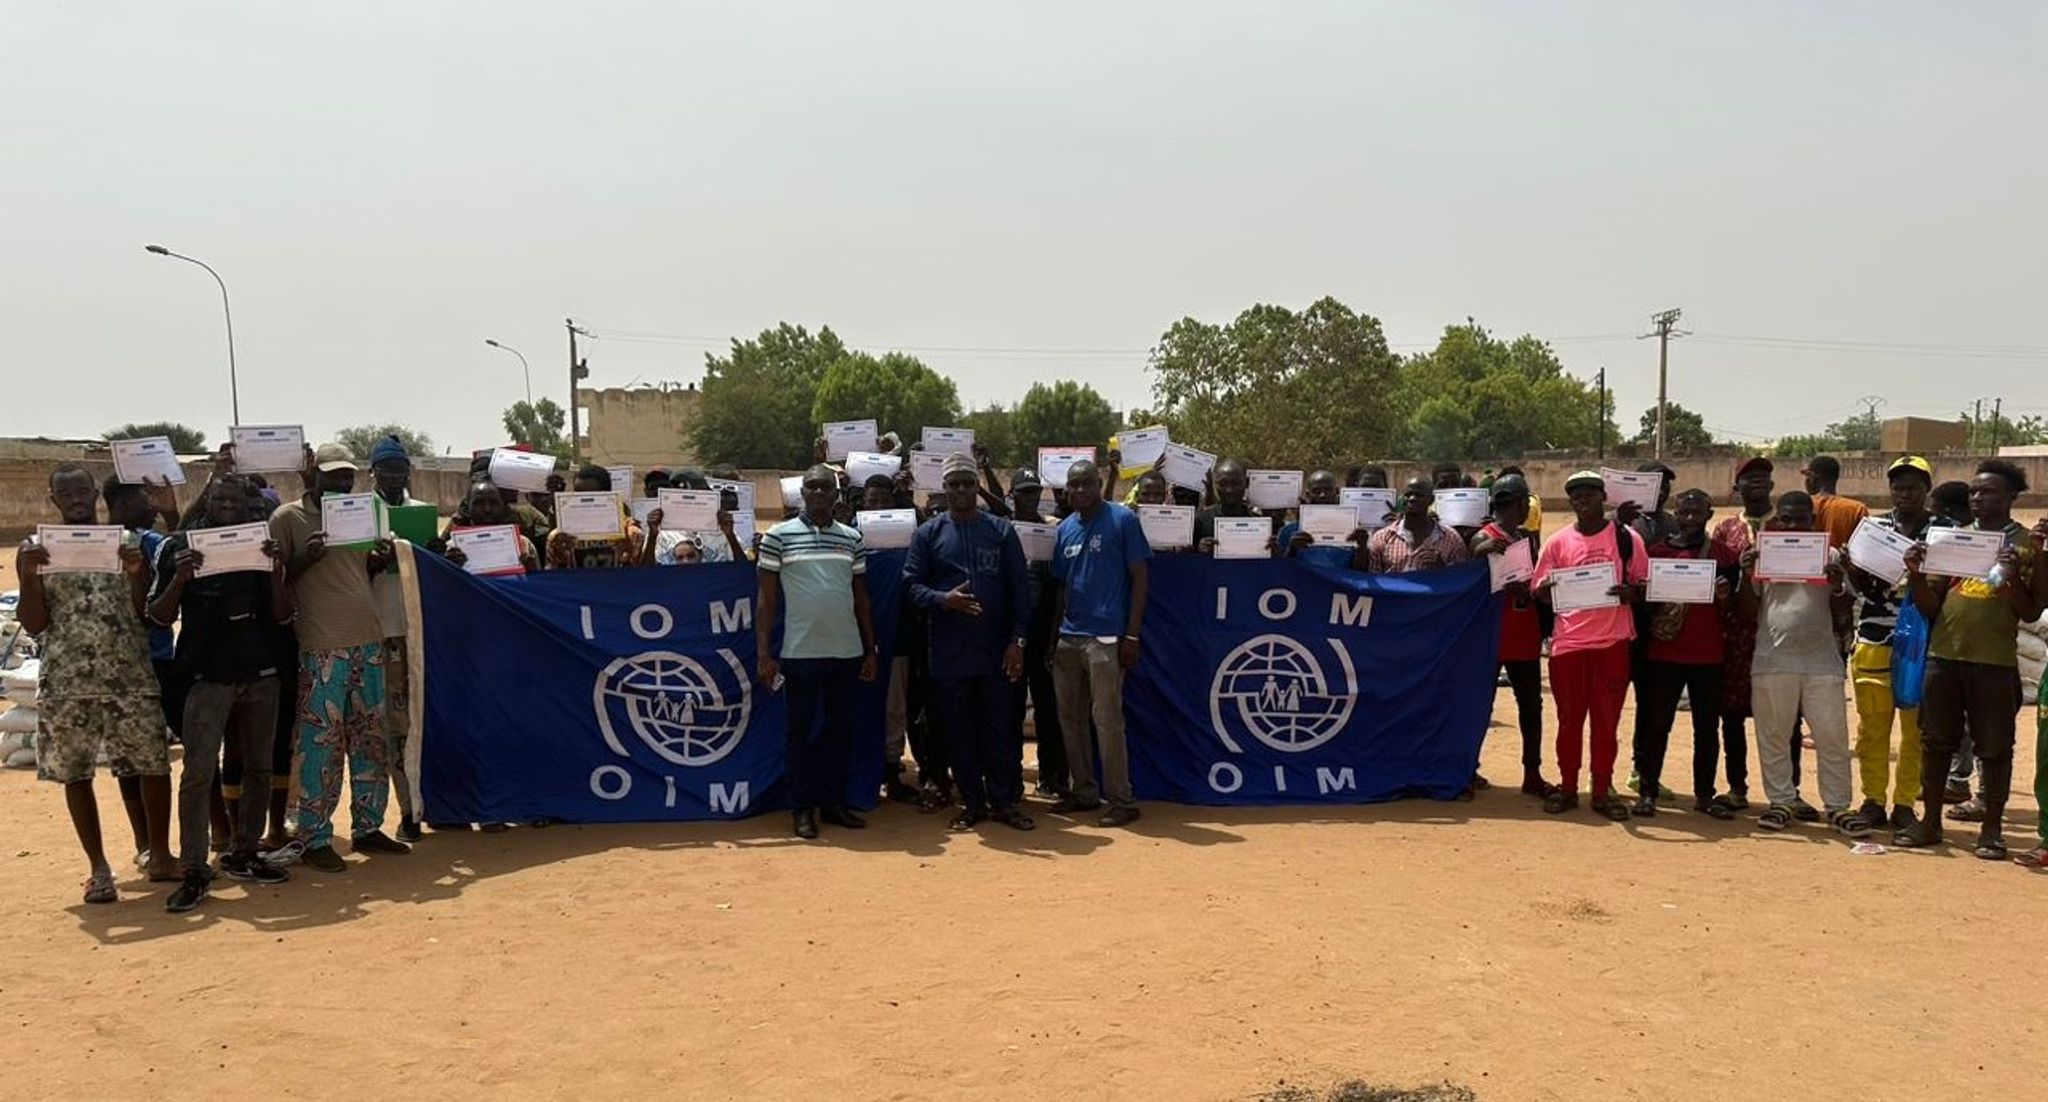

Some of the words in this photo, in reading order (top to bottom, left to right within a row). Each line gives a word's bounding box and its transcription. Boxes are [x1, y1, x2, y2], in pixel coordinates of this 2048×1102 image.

[579, 598, 752, 639] IOM
[1216, 586, 1373, 627] IOM
[590, 765, 749, 814] OIM
[1208, 761, 1356, 794] OIM
